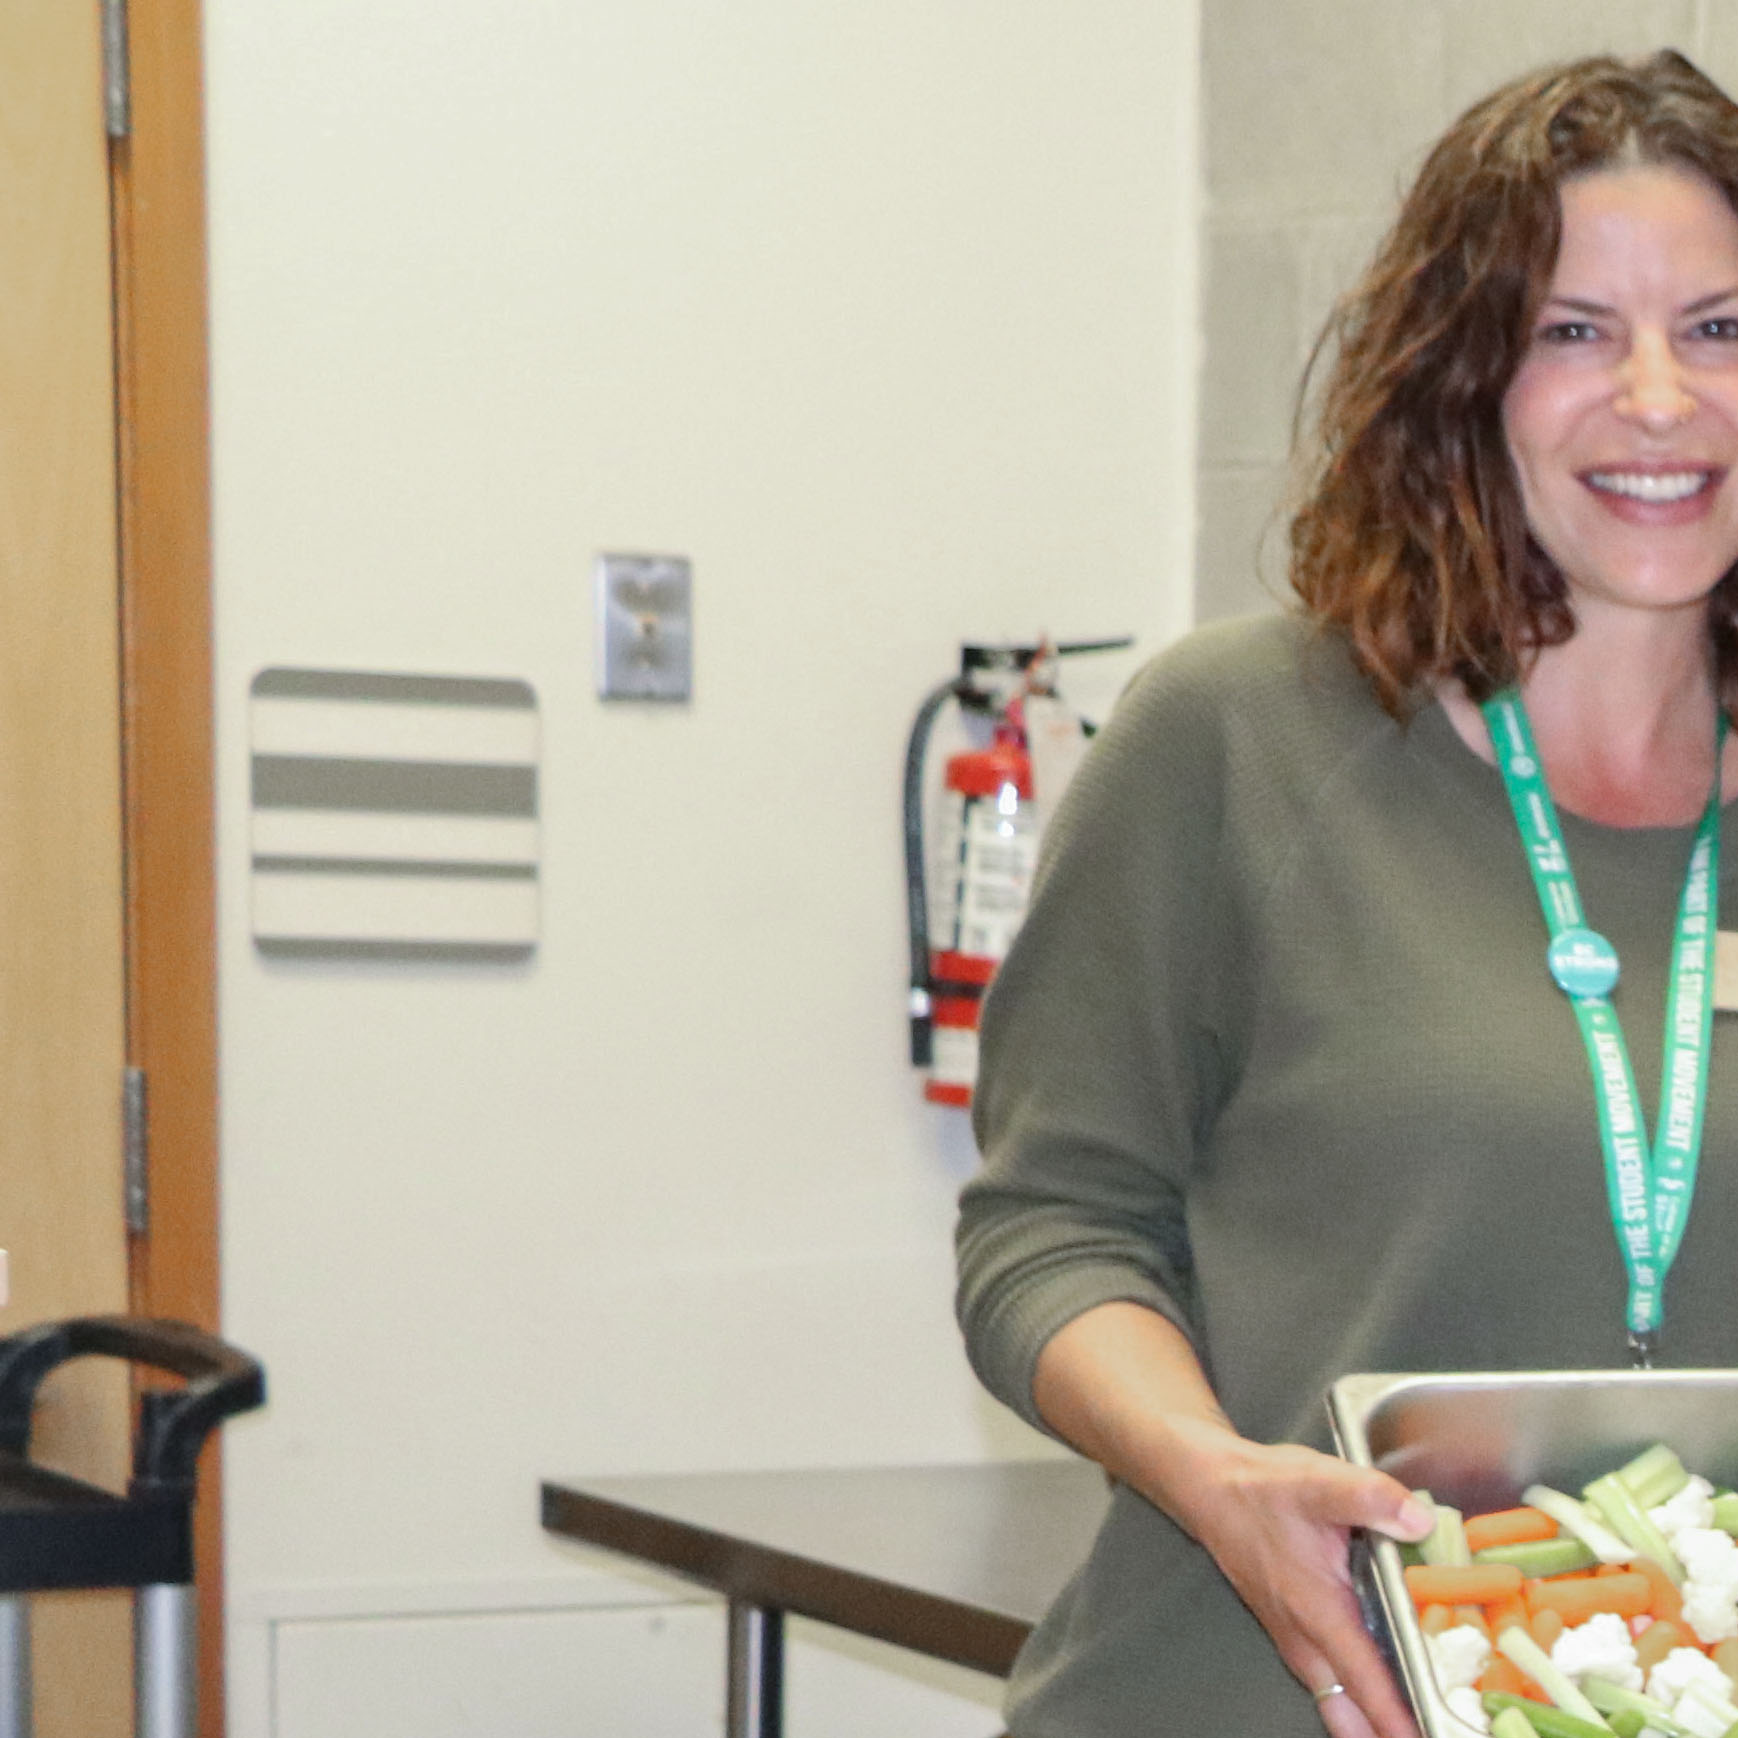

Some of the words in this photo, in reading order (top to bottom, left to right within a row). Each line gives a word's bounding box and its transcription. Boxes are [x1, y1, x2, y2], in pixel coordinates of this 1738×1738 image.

[1678, 938, 1706, 974] THE
[1675, 973, 1704, 1048] STUDENT
[1591, 1029, 1636, 1134] MOVEMENT
[1665, 1047, 1699, 1151] MOVEMENT
[1612, 1136, 1649, 1225] STUDENT
[1623, 1222, 1653, 1259] THE
